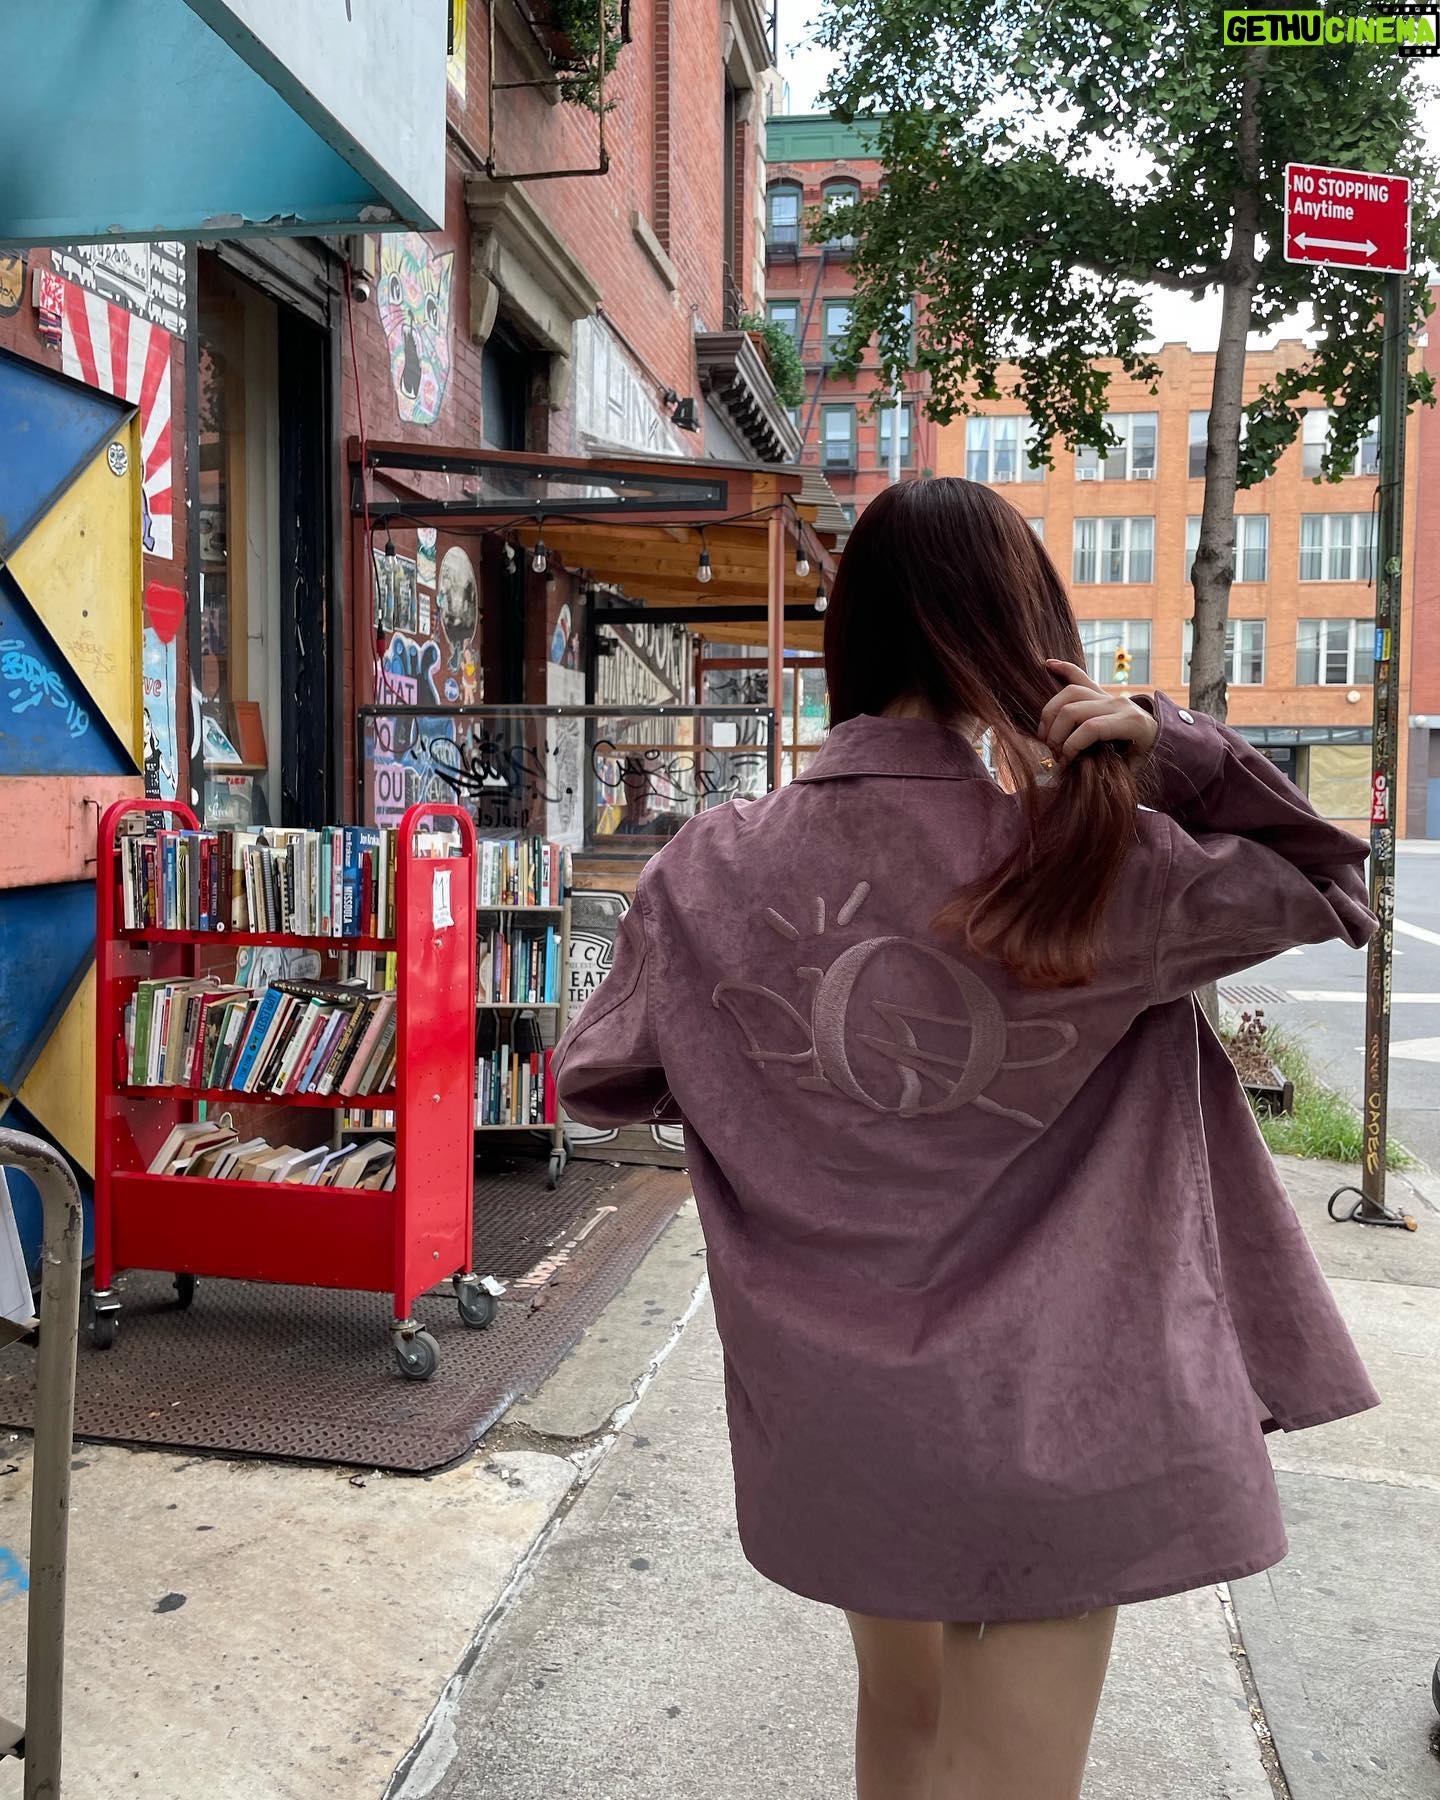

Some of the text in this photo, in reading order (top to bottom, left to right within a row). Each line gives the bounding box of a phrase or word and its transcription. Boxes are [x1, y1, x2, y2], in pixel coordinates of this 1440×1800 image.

[1293, 174, 1389, 201] NO STOPPING
[1293, 198, 1354, 220] Anytime
[343, 886, 353, 923] MISSOULA
